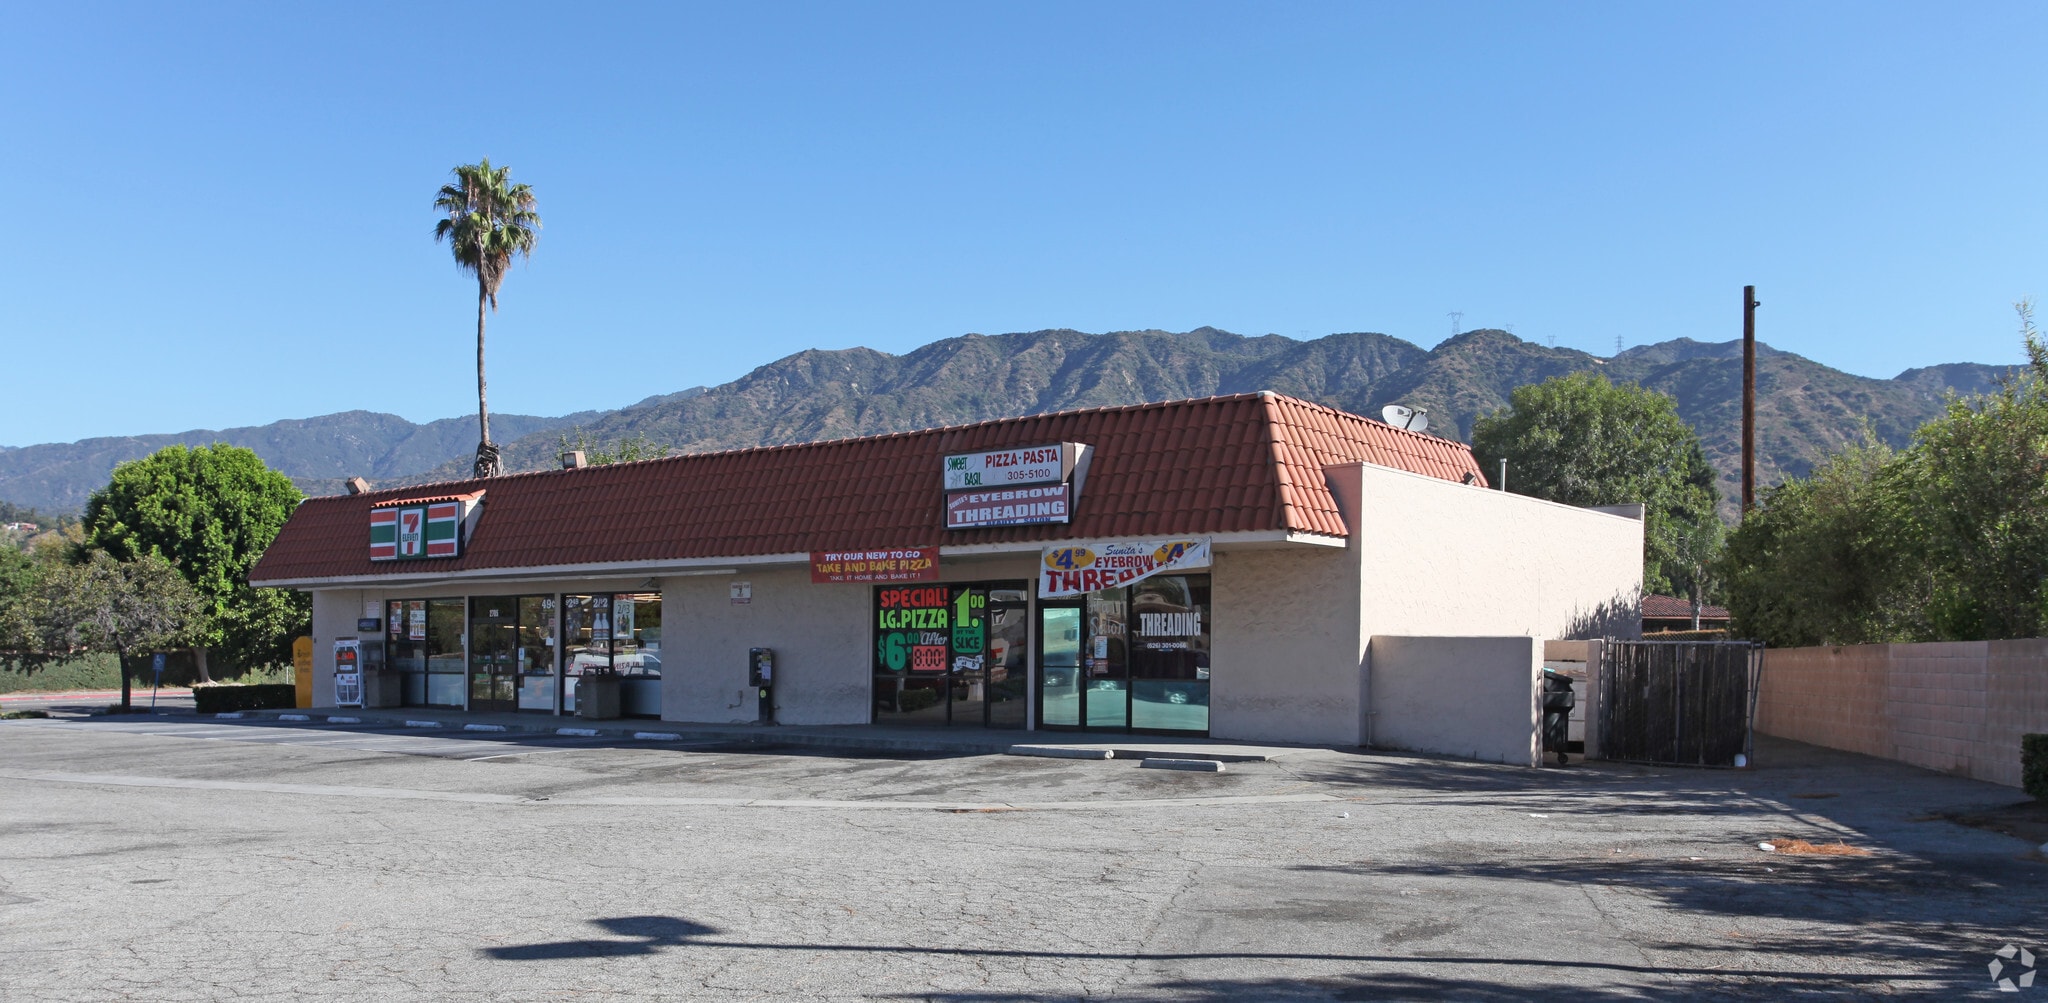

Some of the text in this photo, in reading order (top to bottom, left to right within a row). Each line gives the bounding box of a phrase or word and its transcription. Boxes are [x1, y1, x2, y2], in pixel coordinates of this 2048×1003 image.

[948, 457, 968, 471] SWEET
[985, 449, 1058, 468] PIZZA PASTA
[965, 472, 983, 485] BASIL
[1007, 469, 1051, 480] 305-5100
[969, 486, 1065, 503] EYEBROW
[954, 500, 1065, 522] THREADING
[403, 513, 420, 555] 7
[825, 550, 920, 561] TRY OUR NEW TO GO
[1105, 543, 1143, 555] Sunita's
[816, 558, 932, 573] TAKE AND BAKE PIZZA
[1095, 555, 1154, 568] EYEBROW
[880, 587, 948, 608] SPECIAL!
[1140, 612, 1201, 636] THREADING
[920, 631, 947, 646] After
[956, 636, 980, 649] SLICE
